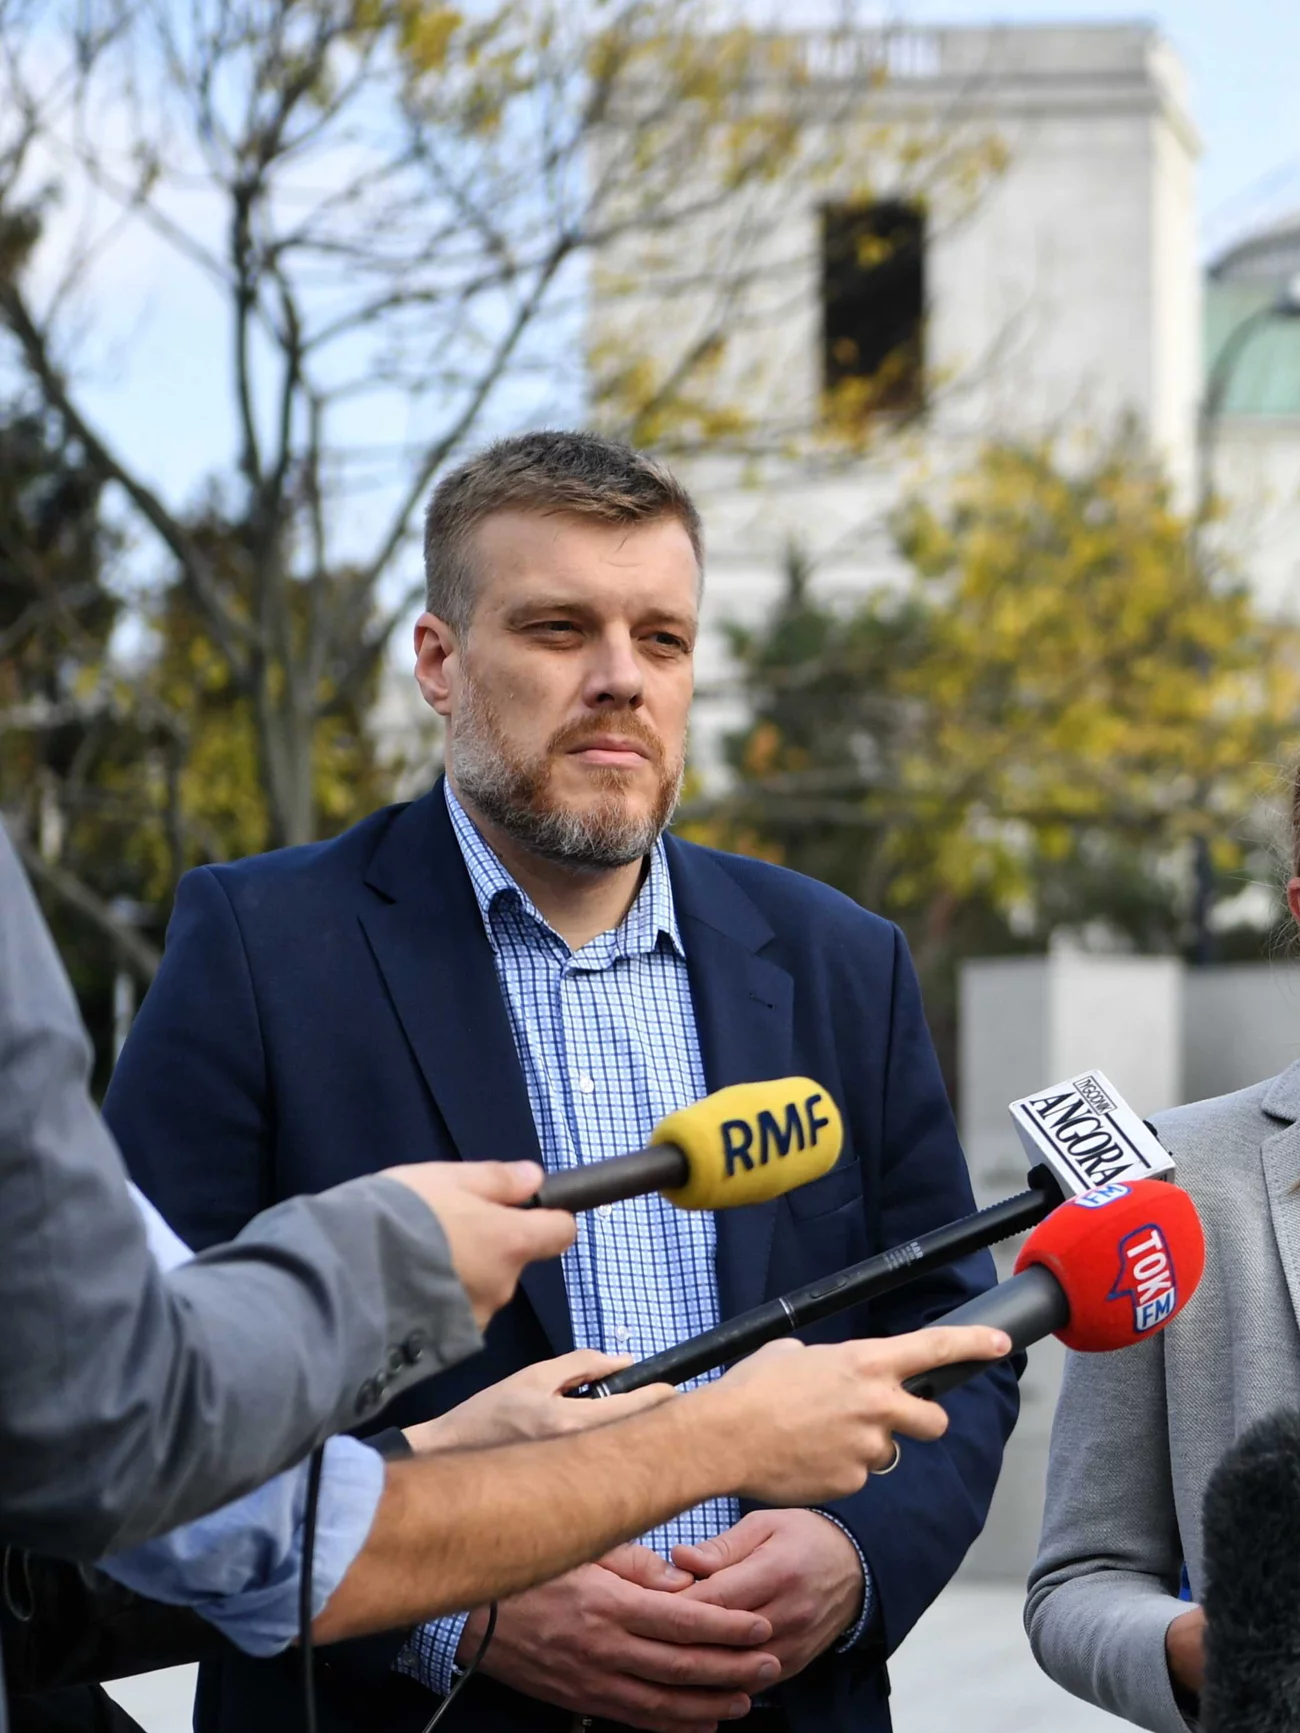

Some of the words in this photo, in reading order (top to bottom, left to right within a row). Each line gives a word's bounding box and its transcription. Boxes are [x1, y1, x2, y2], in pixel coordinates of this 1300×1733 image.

[720, 1094, 829, 1177] RMF
[1029, 1092, 1133, 1187] ANGORA
[1083, 1185, 1124, 1204] FM
[1127, 1229, 1172, 1304] TOK
[1142, 1292, 1171, 1328] FM
